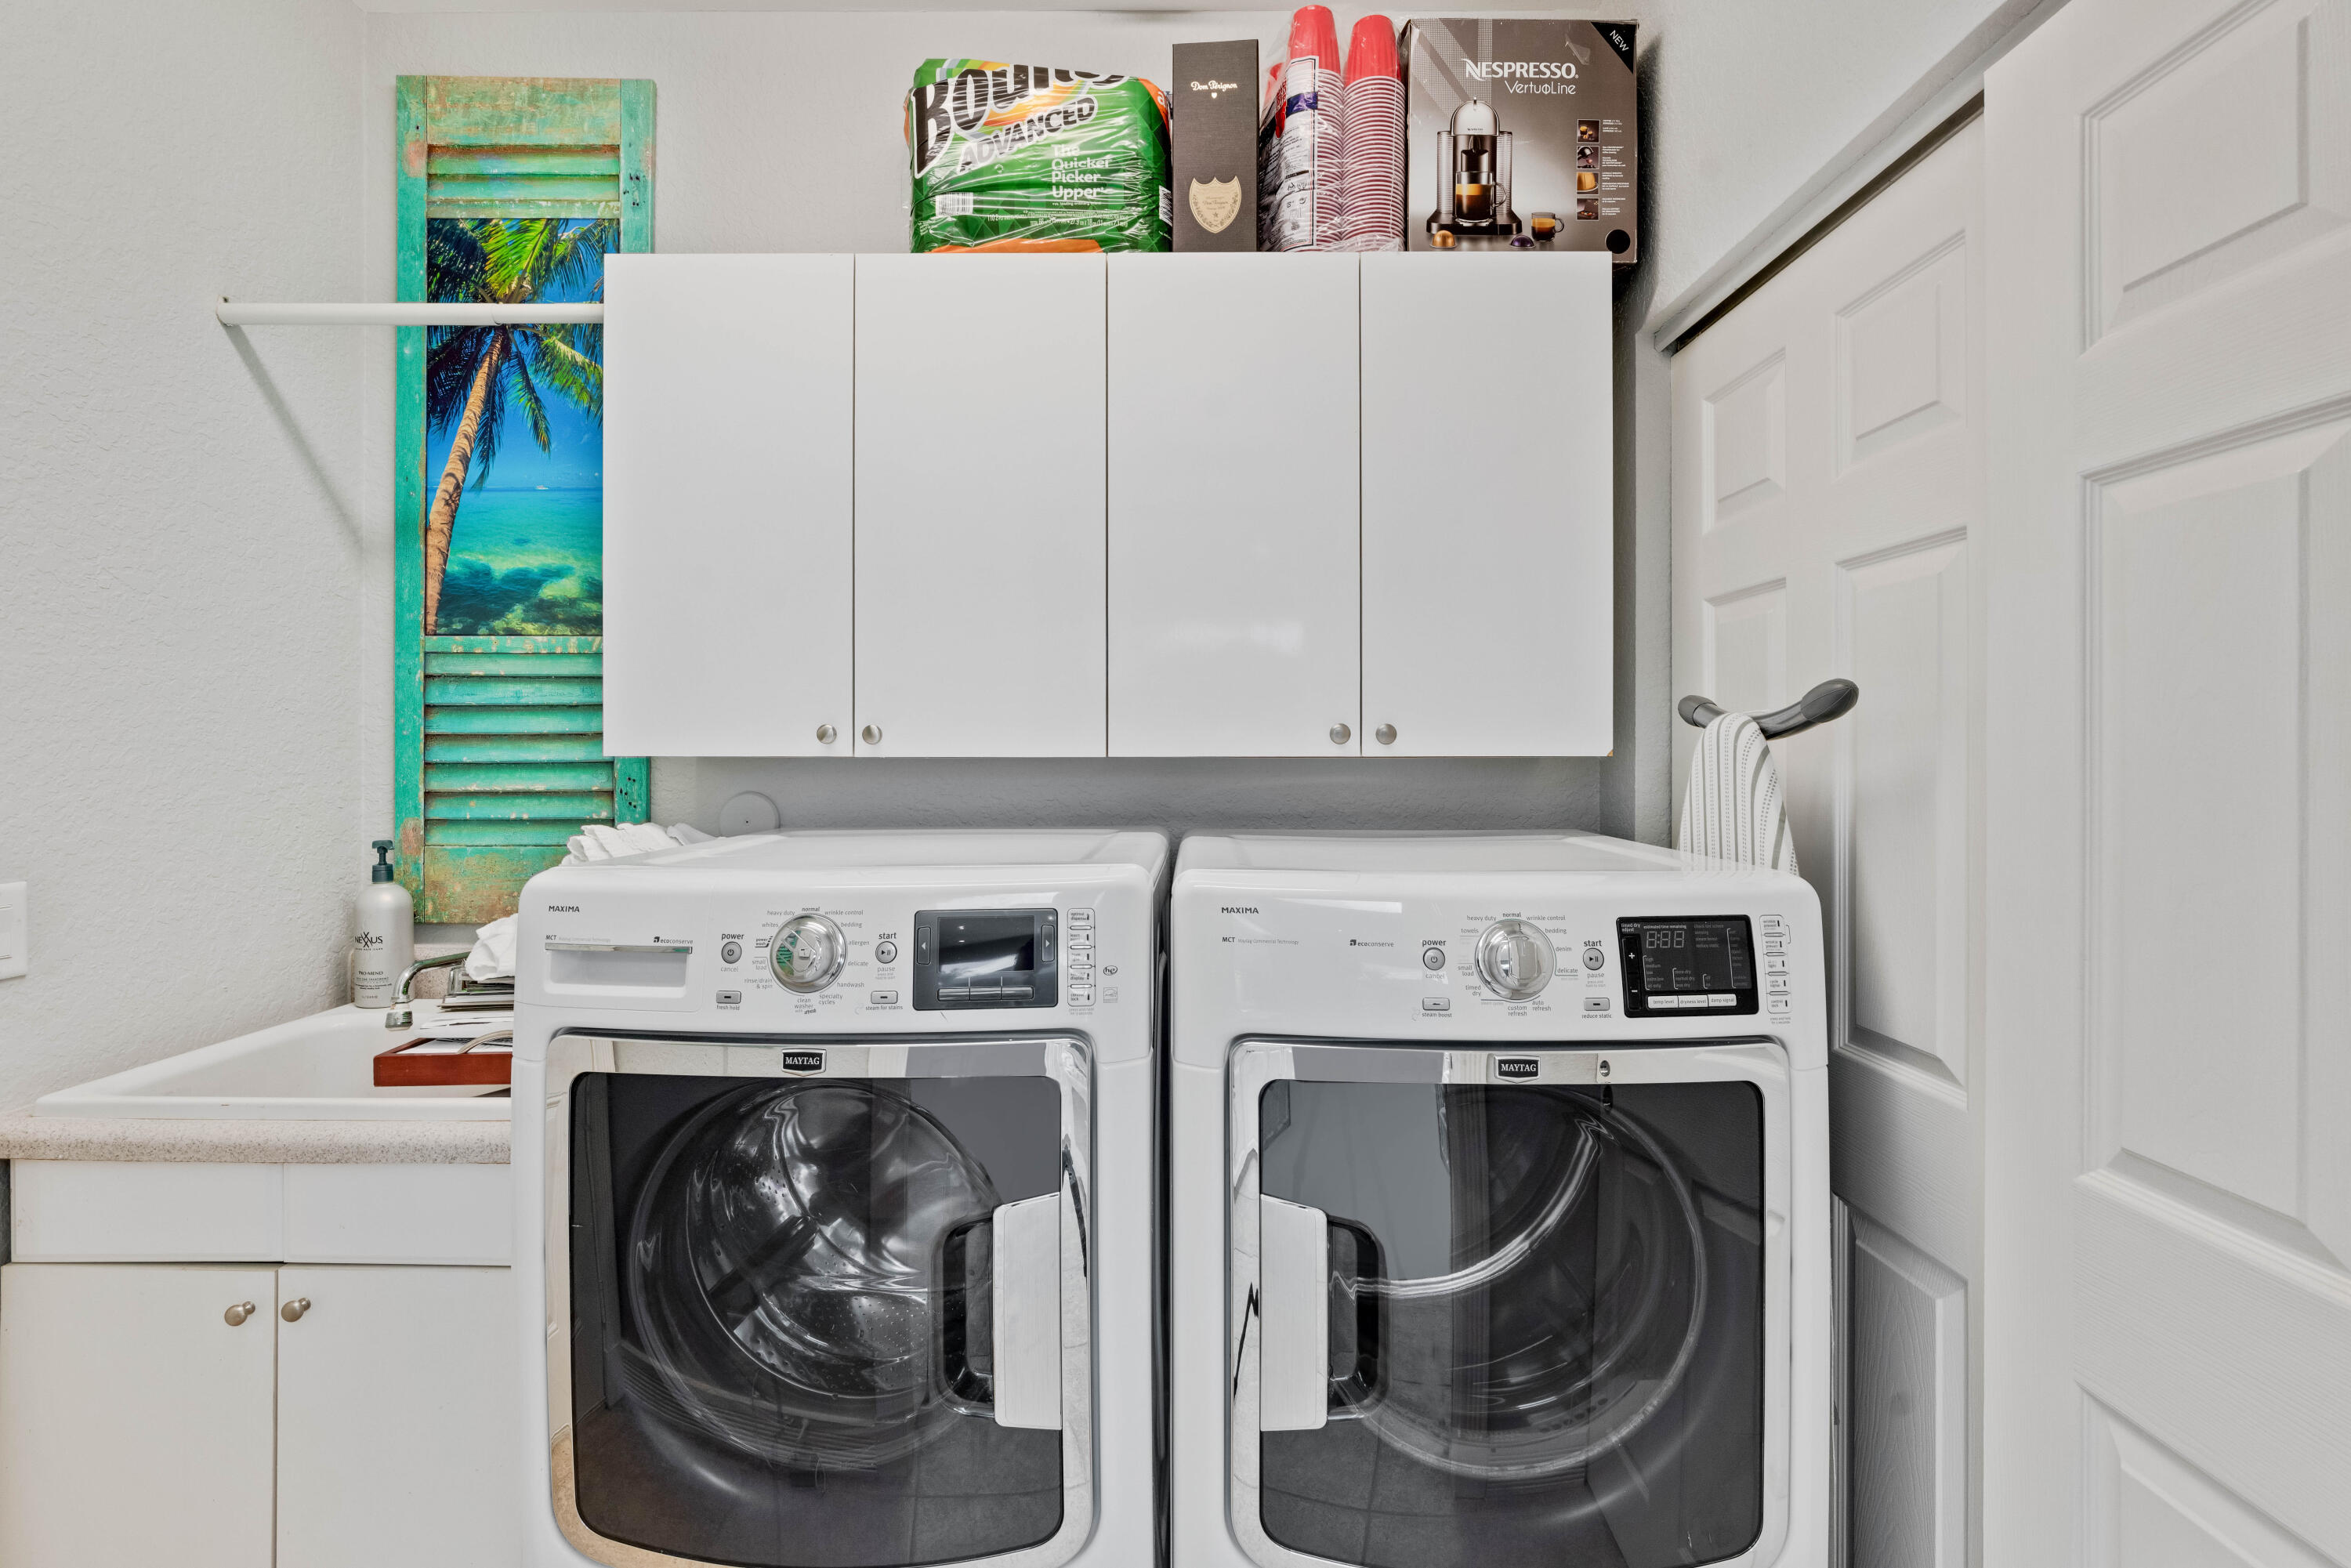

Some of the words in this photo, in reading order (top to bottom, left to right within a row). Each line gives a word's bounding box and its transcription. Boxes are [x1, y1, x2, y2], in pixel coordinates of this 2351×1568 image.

[1609, 29, 1630, 53] NEW
[1462, 58, 1579, 81] NESPRESSO
[1190, 81, 1209, 92] Dom
[956, 99, 1097, 176] ADVANCED
[1052, 144, 1081, 157] The
[1052, 158, 1110, 171] Quicker
[1052, 171, 1101, 183] Picker
[721, 932, 744, 941] power
[785, 1056, 820, 1065] MAYTAG
[1501, 1063, 1537, 1072] MAYTAG
